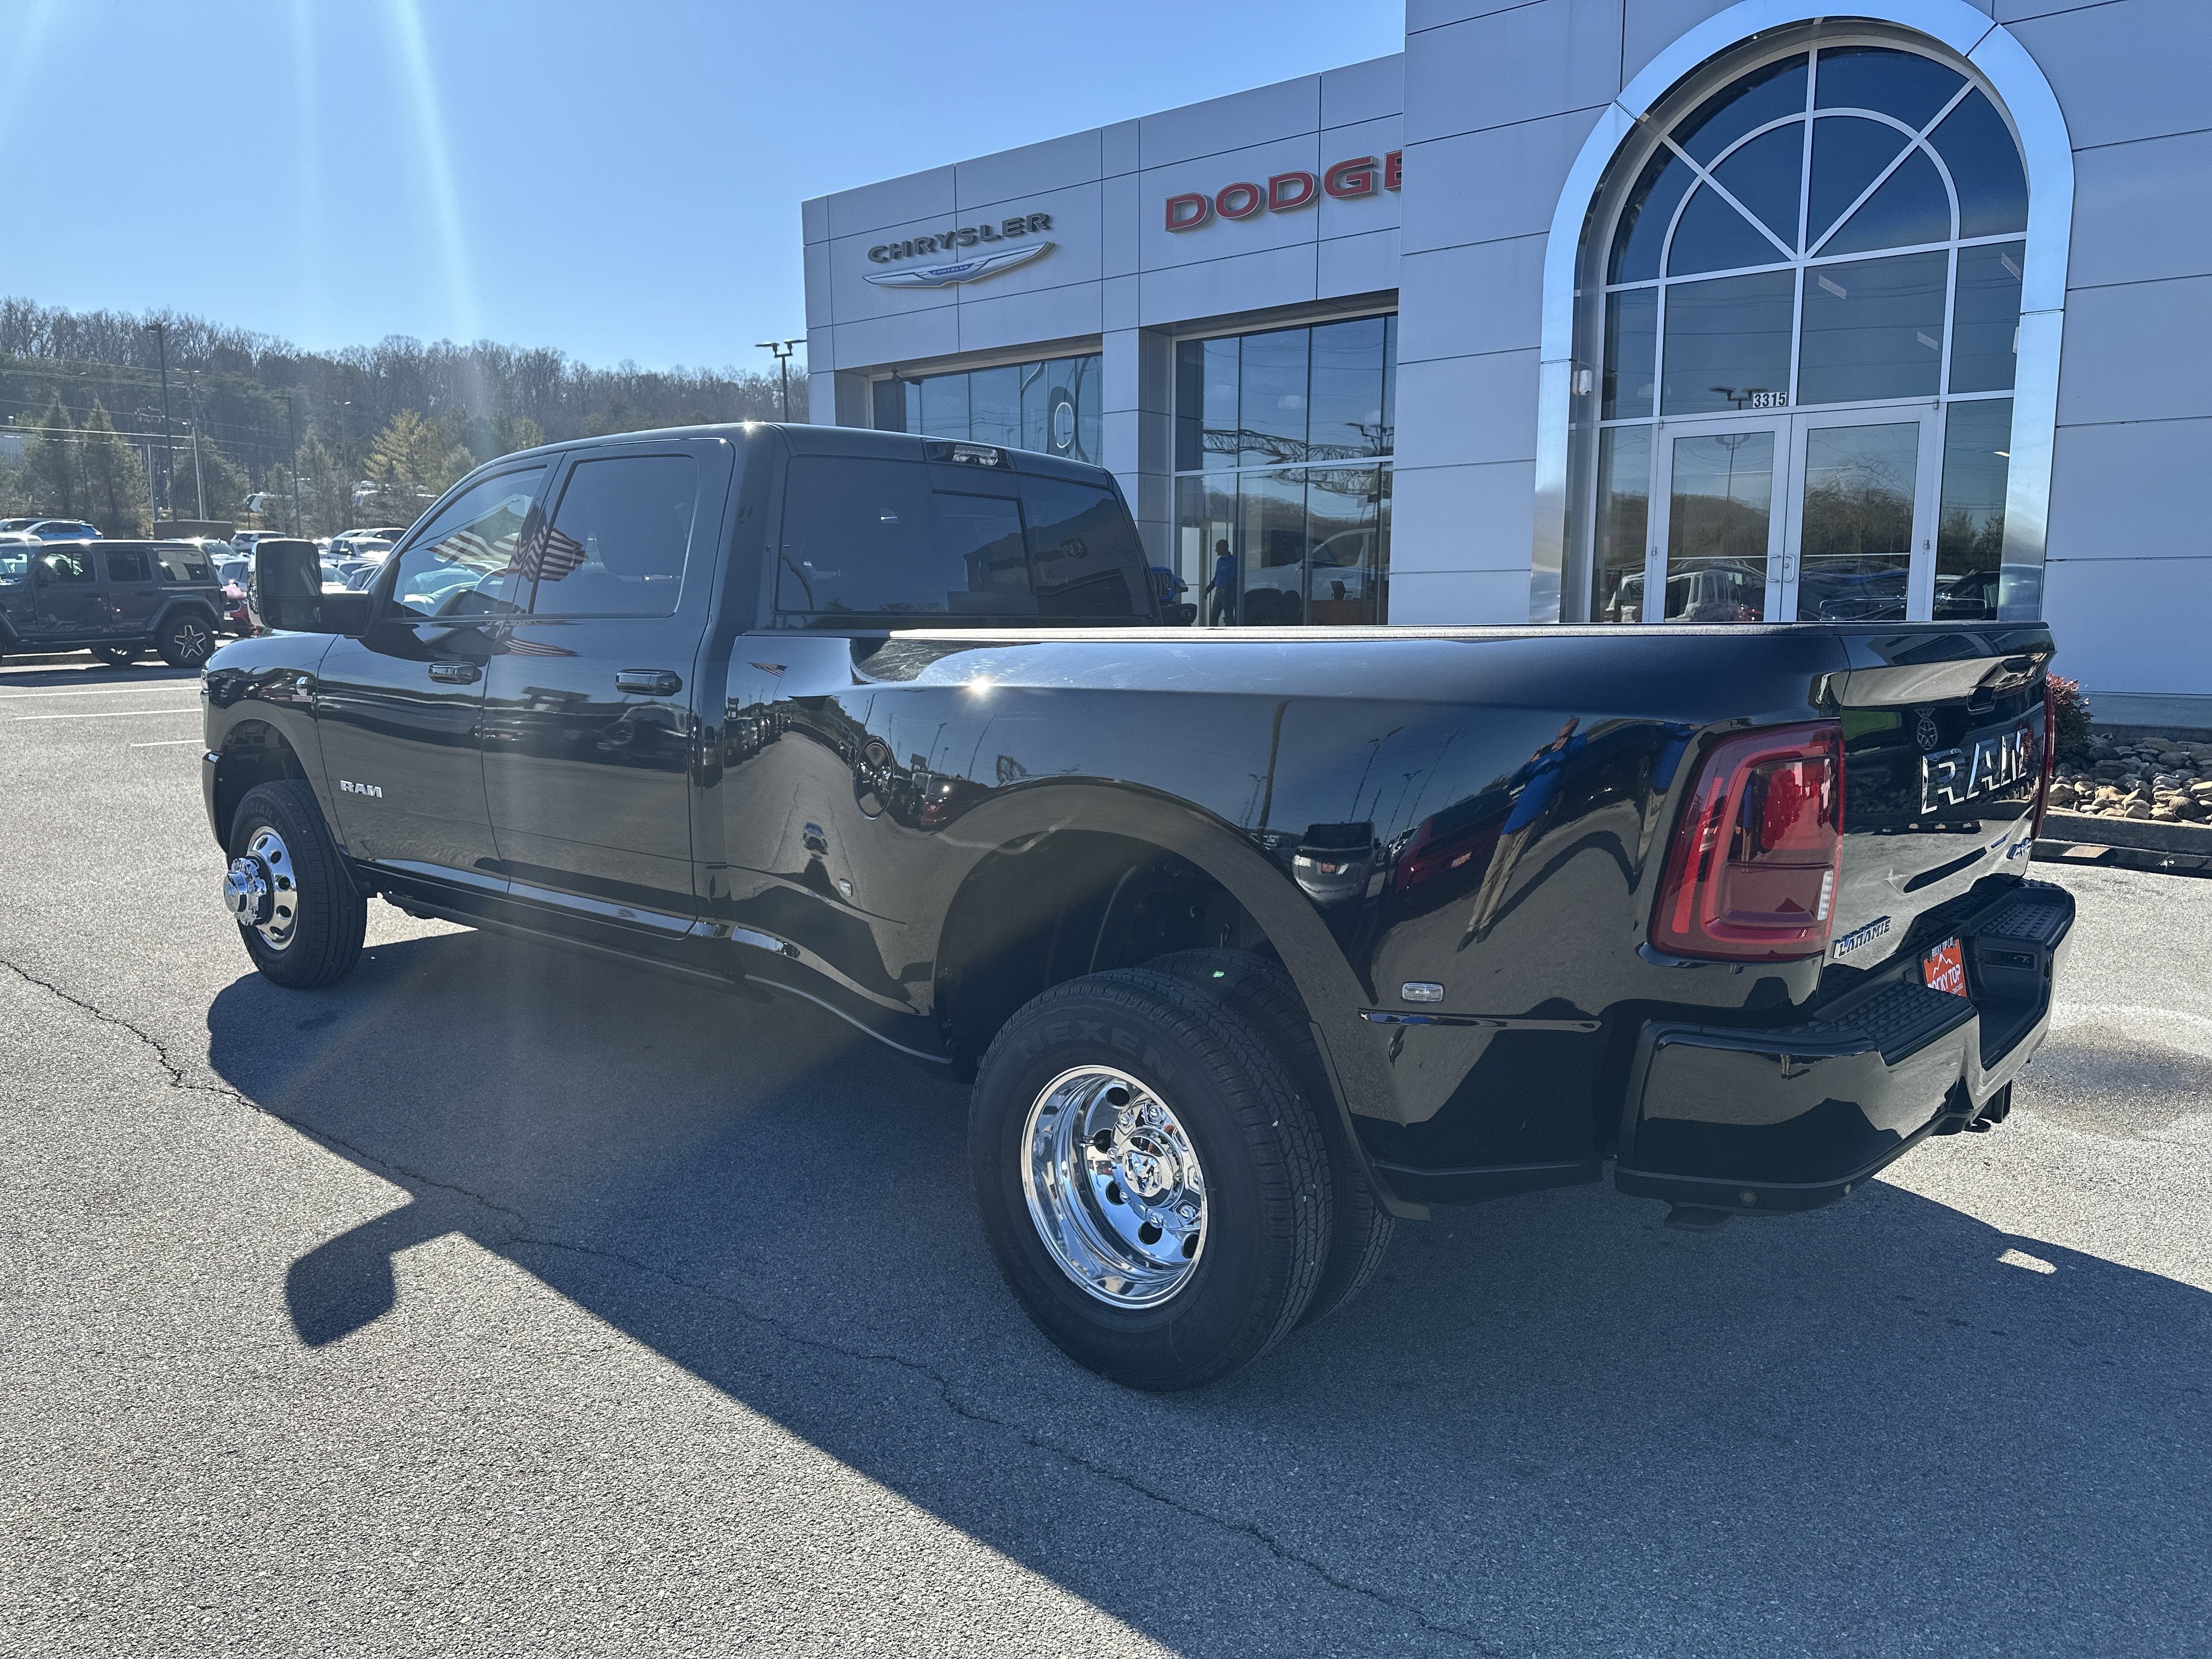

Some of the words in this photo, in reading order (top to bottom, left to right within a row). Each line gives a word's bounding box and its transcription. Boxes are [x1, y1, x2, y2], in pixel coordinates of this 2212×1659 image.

[867, 212, 1051, 263] CHRYSLER
[932, 264, 970, 275] CHRYSLER
[1754, 392, 1786, 408] 3315
[1921, 728, 2029, 814] RAM
[340, 780, 383, 798] RAM
[1831, 916, 1892, 960] LARAMIE
[1948, 963, 1961, 986] TOP
[1020, 1019, 1178, 1085] NEXEN
